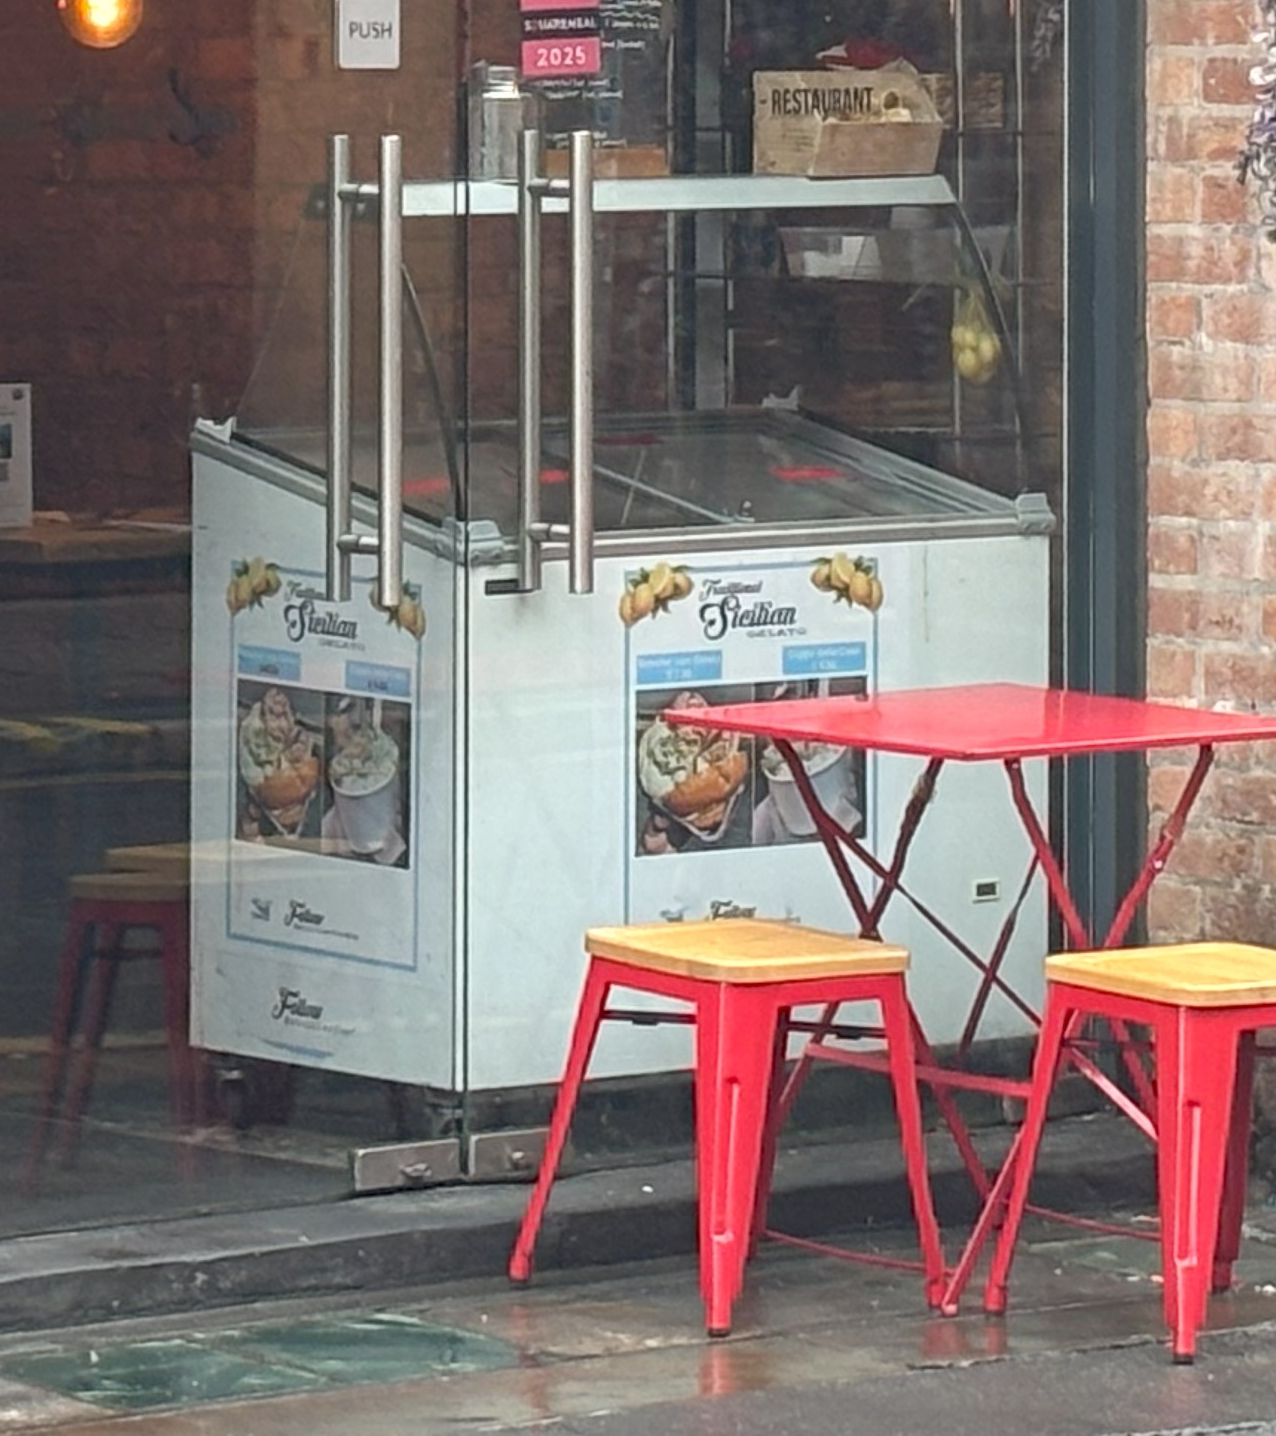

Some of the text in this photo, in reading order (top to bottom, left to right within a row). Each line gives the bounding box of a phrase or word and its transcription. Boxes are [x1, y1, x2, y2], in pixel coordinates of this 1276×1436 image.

[348, 20, 394, 41] PUSH
[536, 45, 587, 67] 2025
[772, 86, 874, 115] RESTAURANT
[699, 595, 797, 641] Sicilian
